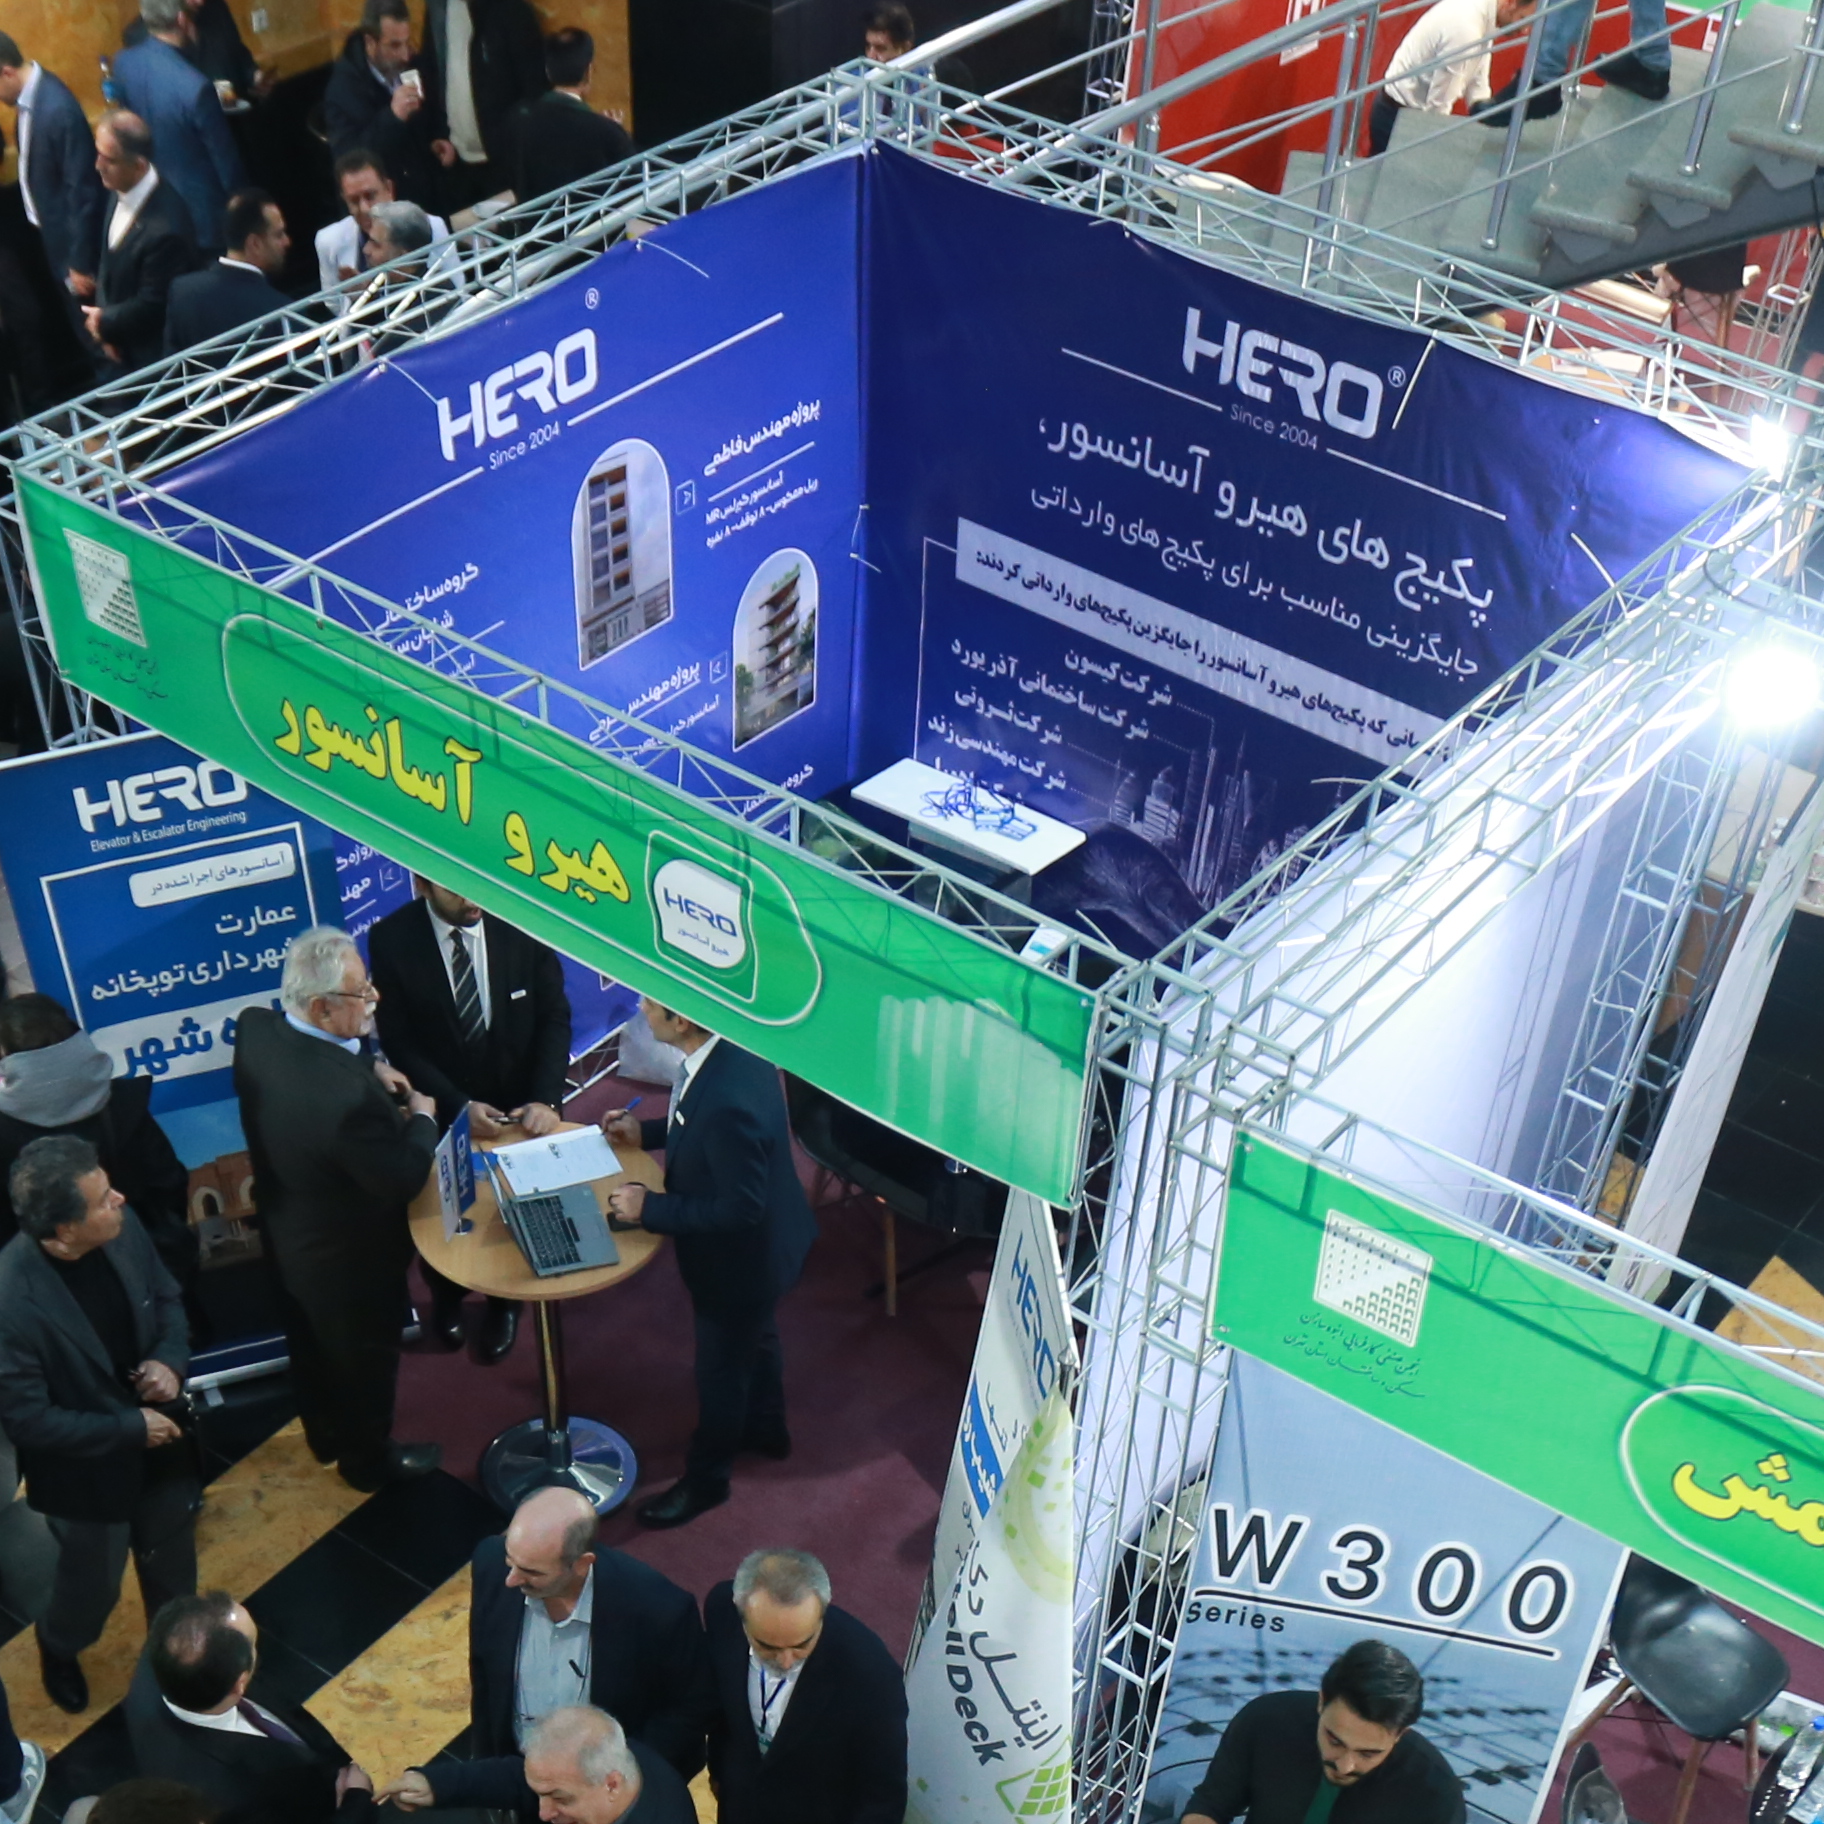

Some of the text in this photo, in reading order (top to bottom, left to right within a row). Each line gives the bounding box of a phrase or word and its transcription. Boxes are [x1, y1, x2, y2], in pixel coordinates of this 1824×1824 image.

[437, 328, 598, 462] HERO
[1182, 306, 1385, 440] HERO
[743, 415, 791, 453] مهندس
[791, 399, 820, 427] پروژه
[1229, 402, 1319, 451] Since 2004
[488, 421, 560, 470] Since 2004
[1214, 478, 1308, 540] هیرو
[1316, 518, 1391, 570] های
[443, 562, 479, 593] گروه
[1021, 571, 1074, 607] وارداتی
[1030, 483, 1478, 682] جایگزینی مناسب برای پکیج های وارداتی
[1392, 551, 1495, 628] پکیج
[1119, 674, 1174, 706] شرکت
[1207, 655, 1268, 684] آسانسور
[1014, 714, 1063, 746] شرکت
[1018, 670, 1150, 740] شرکت ساختمانی
[73, 759, 248, 833] HERO
[1018, 760, 1067, 791] شرکت
[273, 699, 632, 904] هیرو آسانسور
[90, 832, 131, 852] Elevator
[141, 821, 186, 842] Escalator
[186, 809, 248, 834] Engineering
[215, 904, 296, 936] عمارت
[664, 886, 737, 939] HERO
[90, 964, 187, 1002] توپخانه
[121, 1016, 213, 1078] شهر
[1010, 1229, 1056, 1400] HERO
[1185, 1600, 1285, 1635] Series
[946, 1663, 1008, 1767] Deck
[967, 1629, 1063, 1751] اینتل
